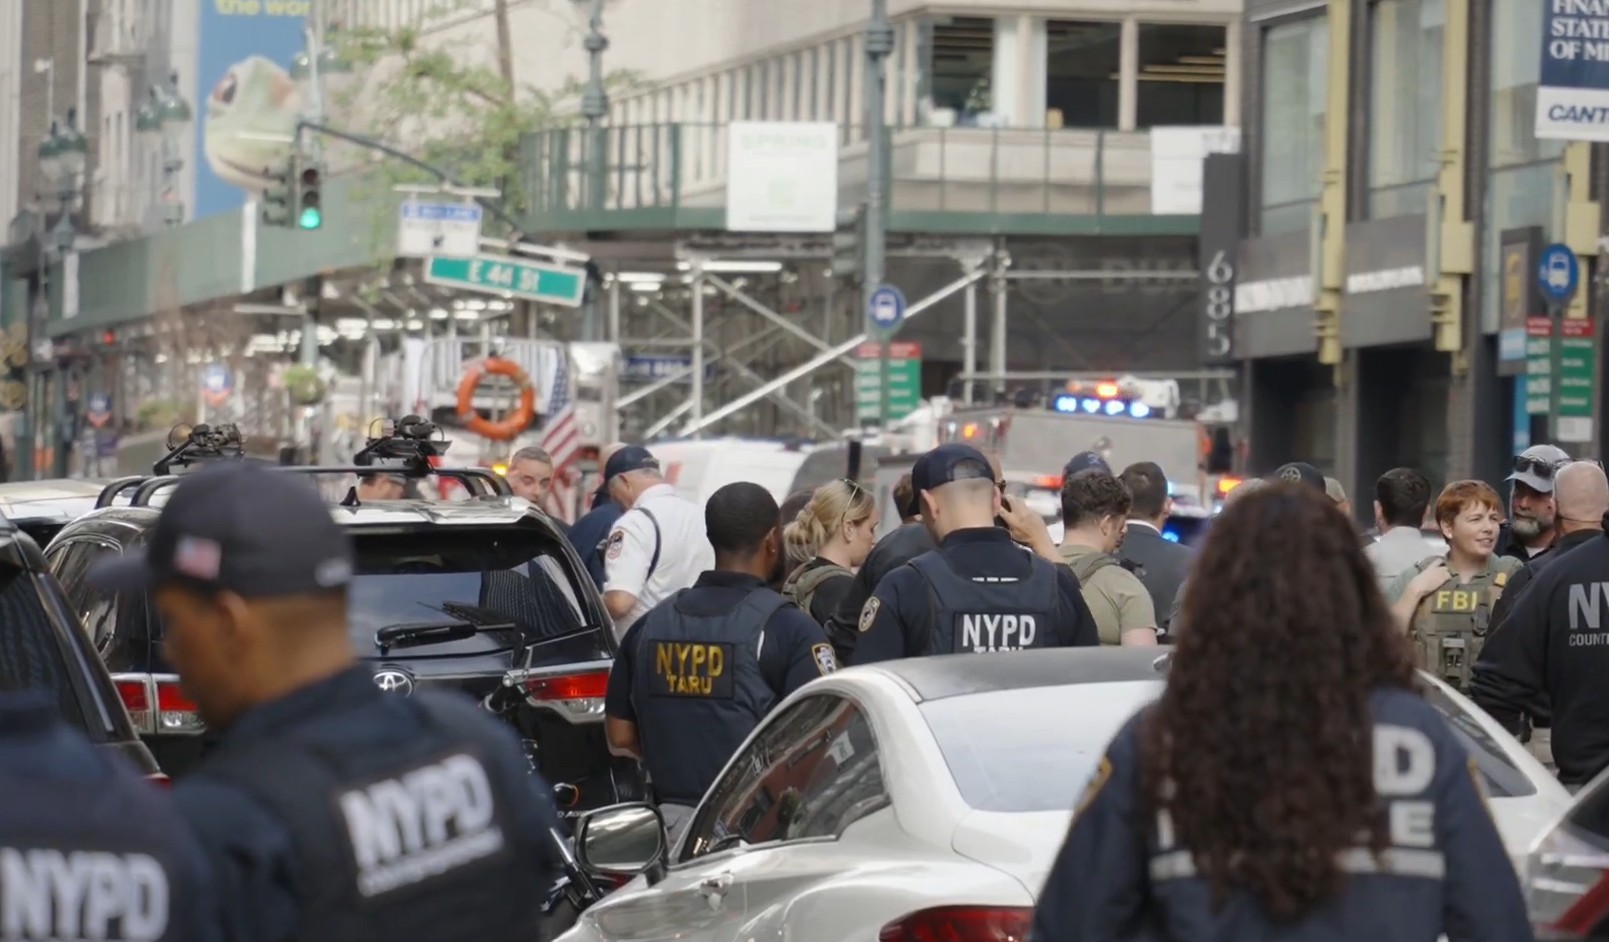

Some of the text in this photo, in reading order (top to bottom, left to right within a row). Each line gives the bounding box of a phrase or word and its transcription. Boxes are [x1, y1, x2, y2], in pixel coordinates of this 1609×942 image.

[1549, 39, 1581, 60] OF
[468, 260, 482, 284] E
[1436, 590, 1479, 611] FBI
[962, 613, 1036, 648] NYPD
[656, 642, 724, 677] NYPD
[665, 674, 713, 695] TARU
[340, 753, 494, 873] NYPD
[0, 846, 170, 942] NYPD
